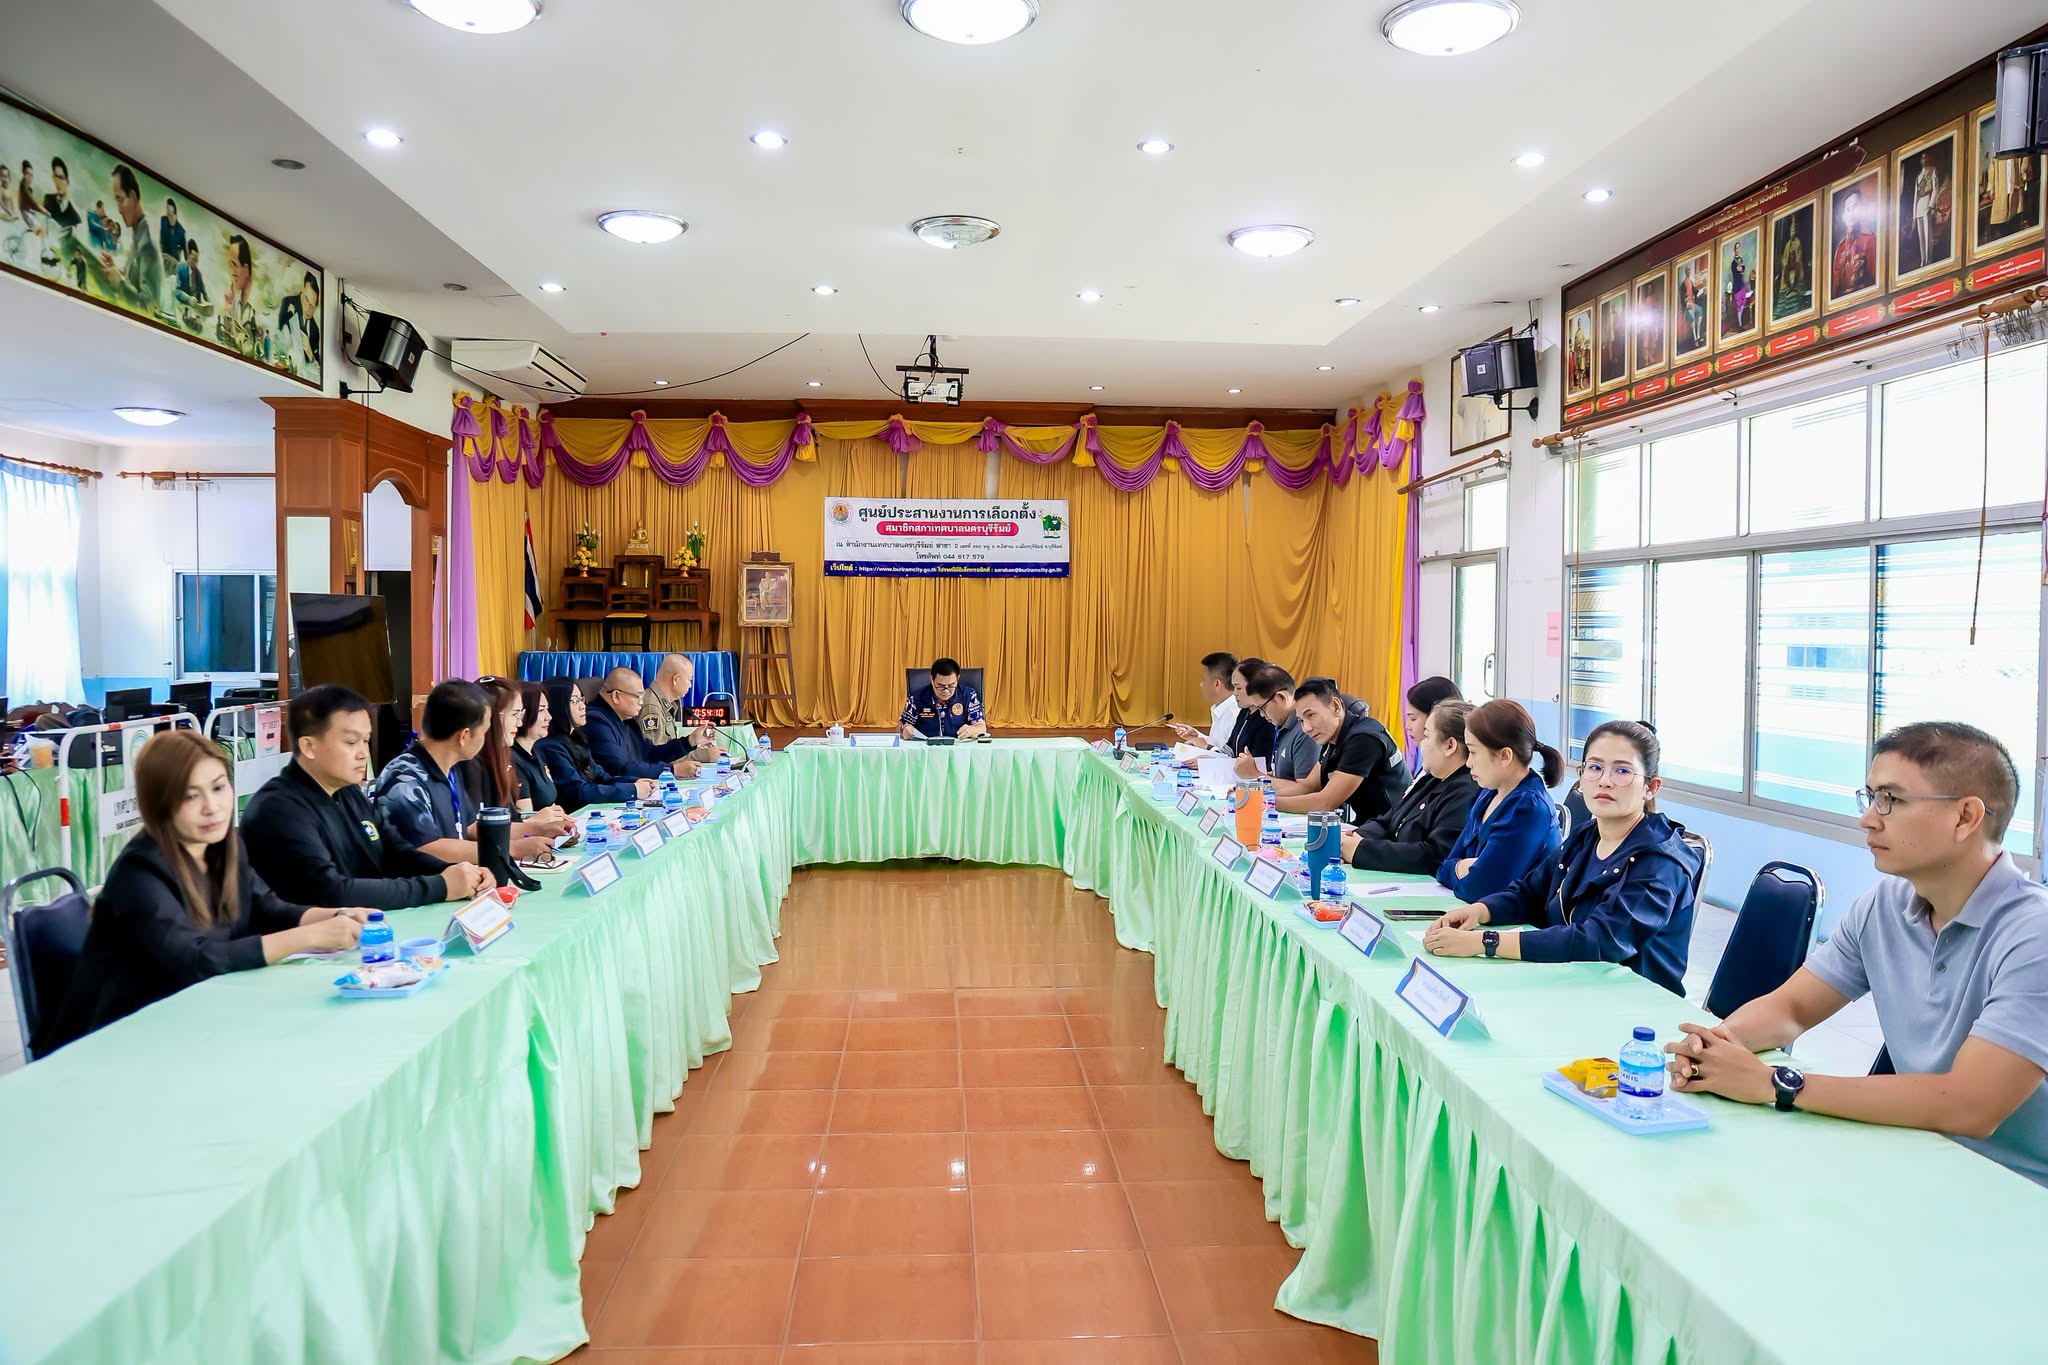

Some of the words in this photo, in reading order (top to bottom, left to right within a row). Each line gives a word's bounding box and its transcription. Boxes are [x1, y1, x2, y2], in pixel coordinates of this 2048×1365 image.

[858, 502, 1036, 522] ศูนย์ประสานงานการเลือกตั้ง
[885, 522, 1012, 535] สมาชิกสภาเทศบาลนครบุรีรัมย์
